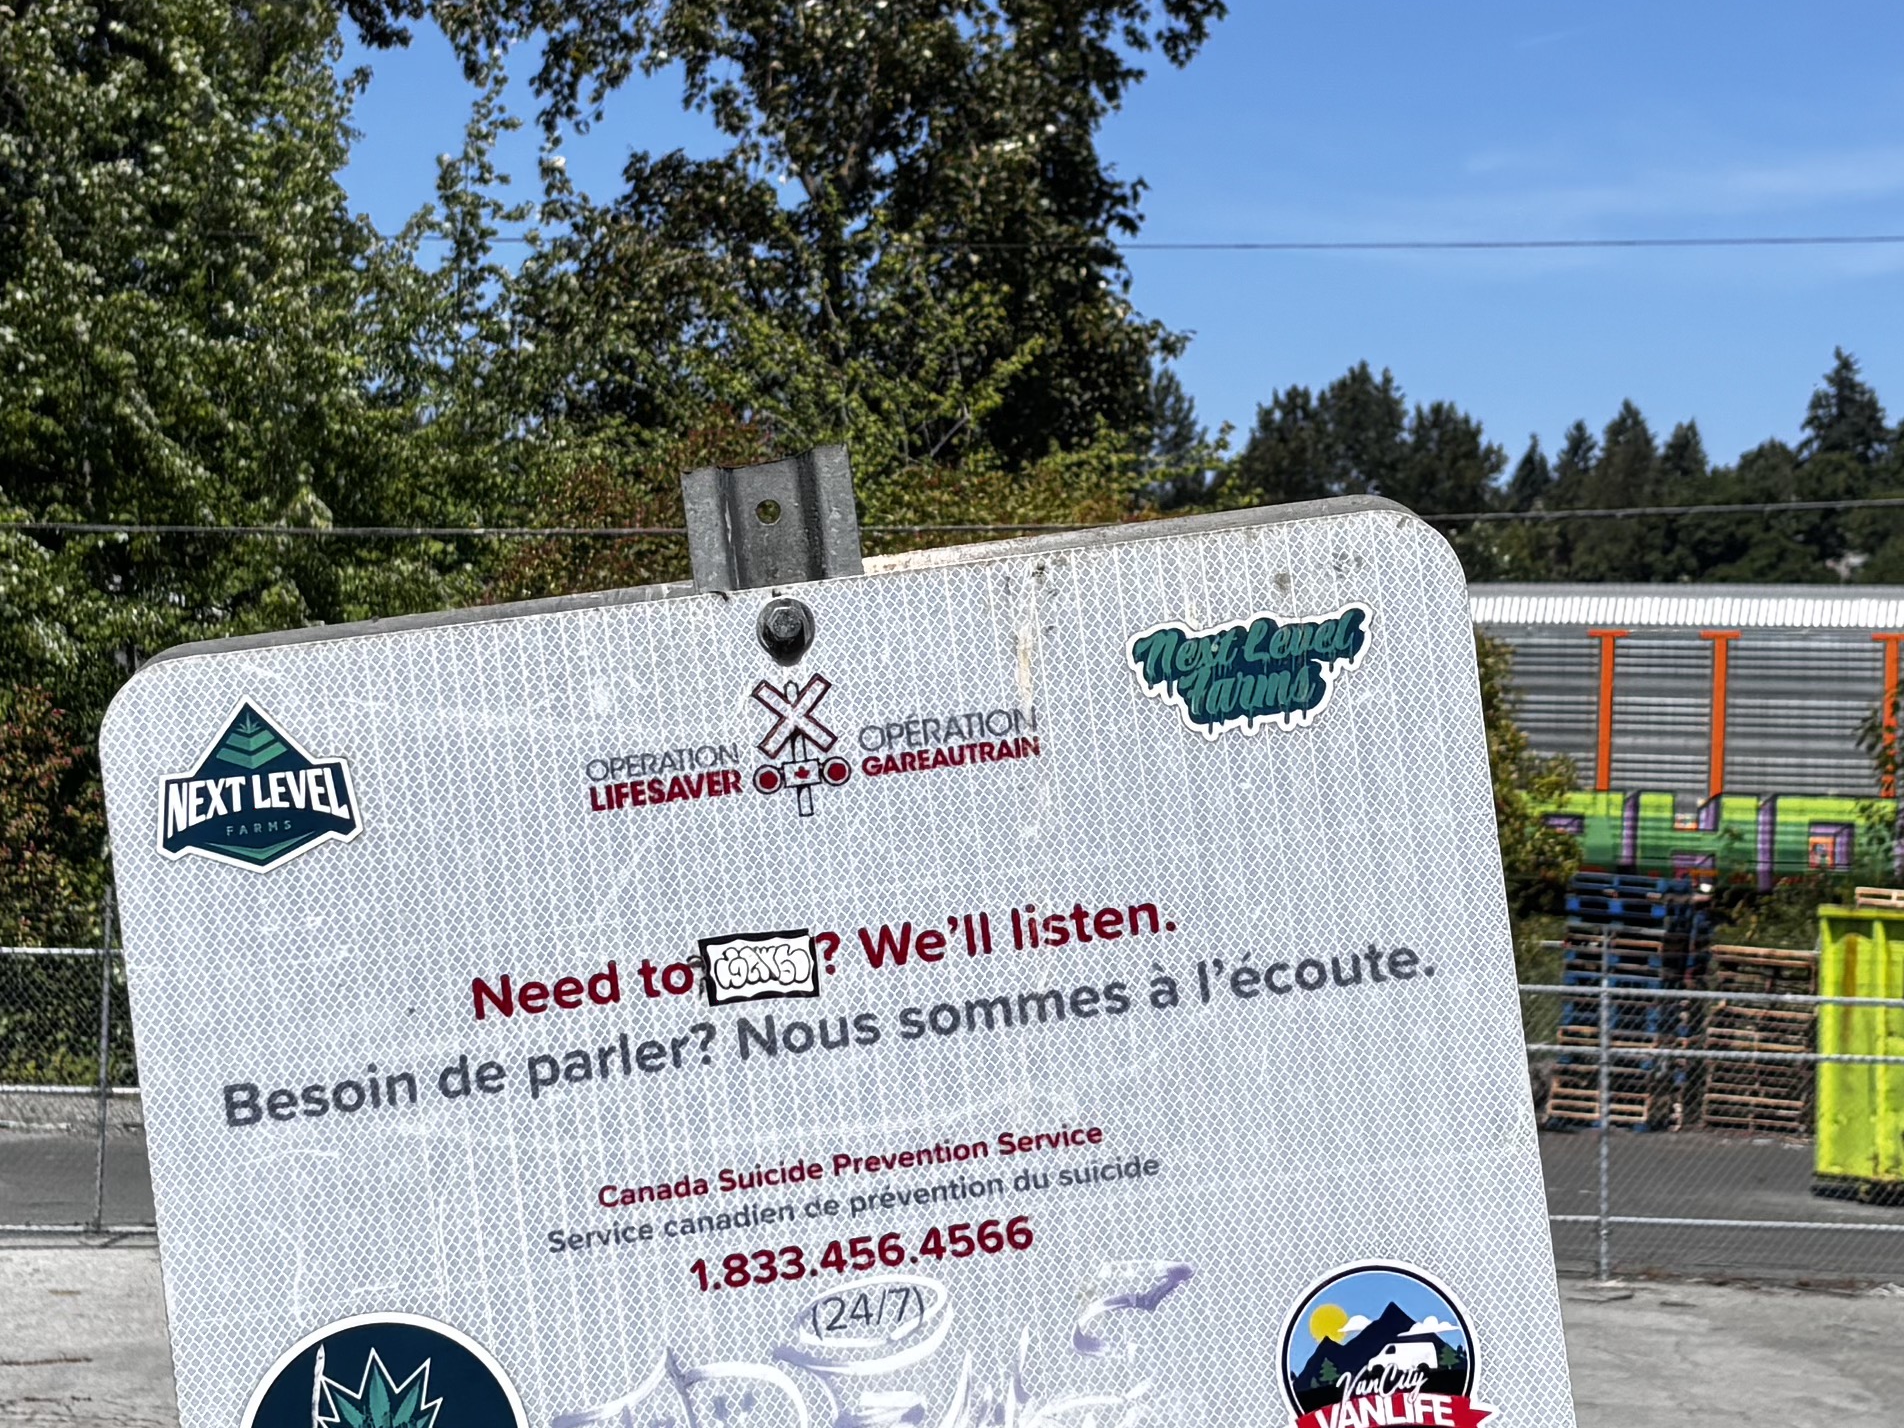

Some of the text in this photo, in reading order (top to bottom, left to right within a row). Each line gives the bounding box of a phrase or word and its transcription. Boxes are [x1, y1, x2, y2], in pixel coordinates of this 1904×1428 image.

[858, 706, 1038, 753] OPÉRATION
[862, 736, 1041, 777] GAREAUTRAIN
[585, 742, 739, 783] OPERATION
[589, 770, 744, 811] LIFESAVER
[167, 768, 350, 839] NEXT LEVEL
[226, 820, 292, 836] FARMS
[471, 961, 621, 1020] Need
[641, 959, 694, 998] to
[858, 913, 994, 967] We'll
[1011, 902, 1178, 950] listen.
[223, 938, 1436, 1128] Besoin de parler? Nous sommes à l'écoute.
[597, 1125, 1103, 1209] Canada Suicide Prevention Service
[547, 1154, 1161, 1254] Service canadien de prévention du suicide
[688, 1214, 1036, 1293] 1.833.456.4566
[811, 1285, 927, 1340] (24/7)
